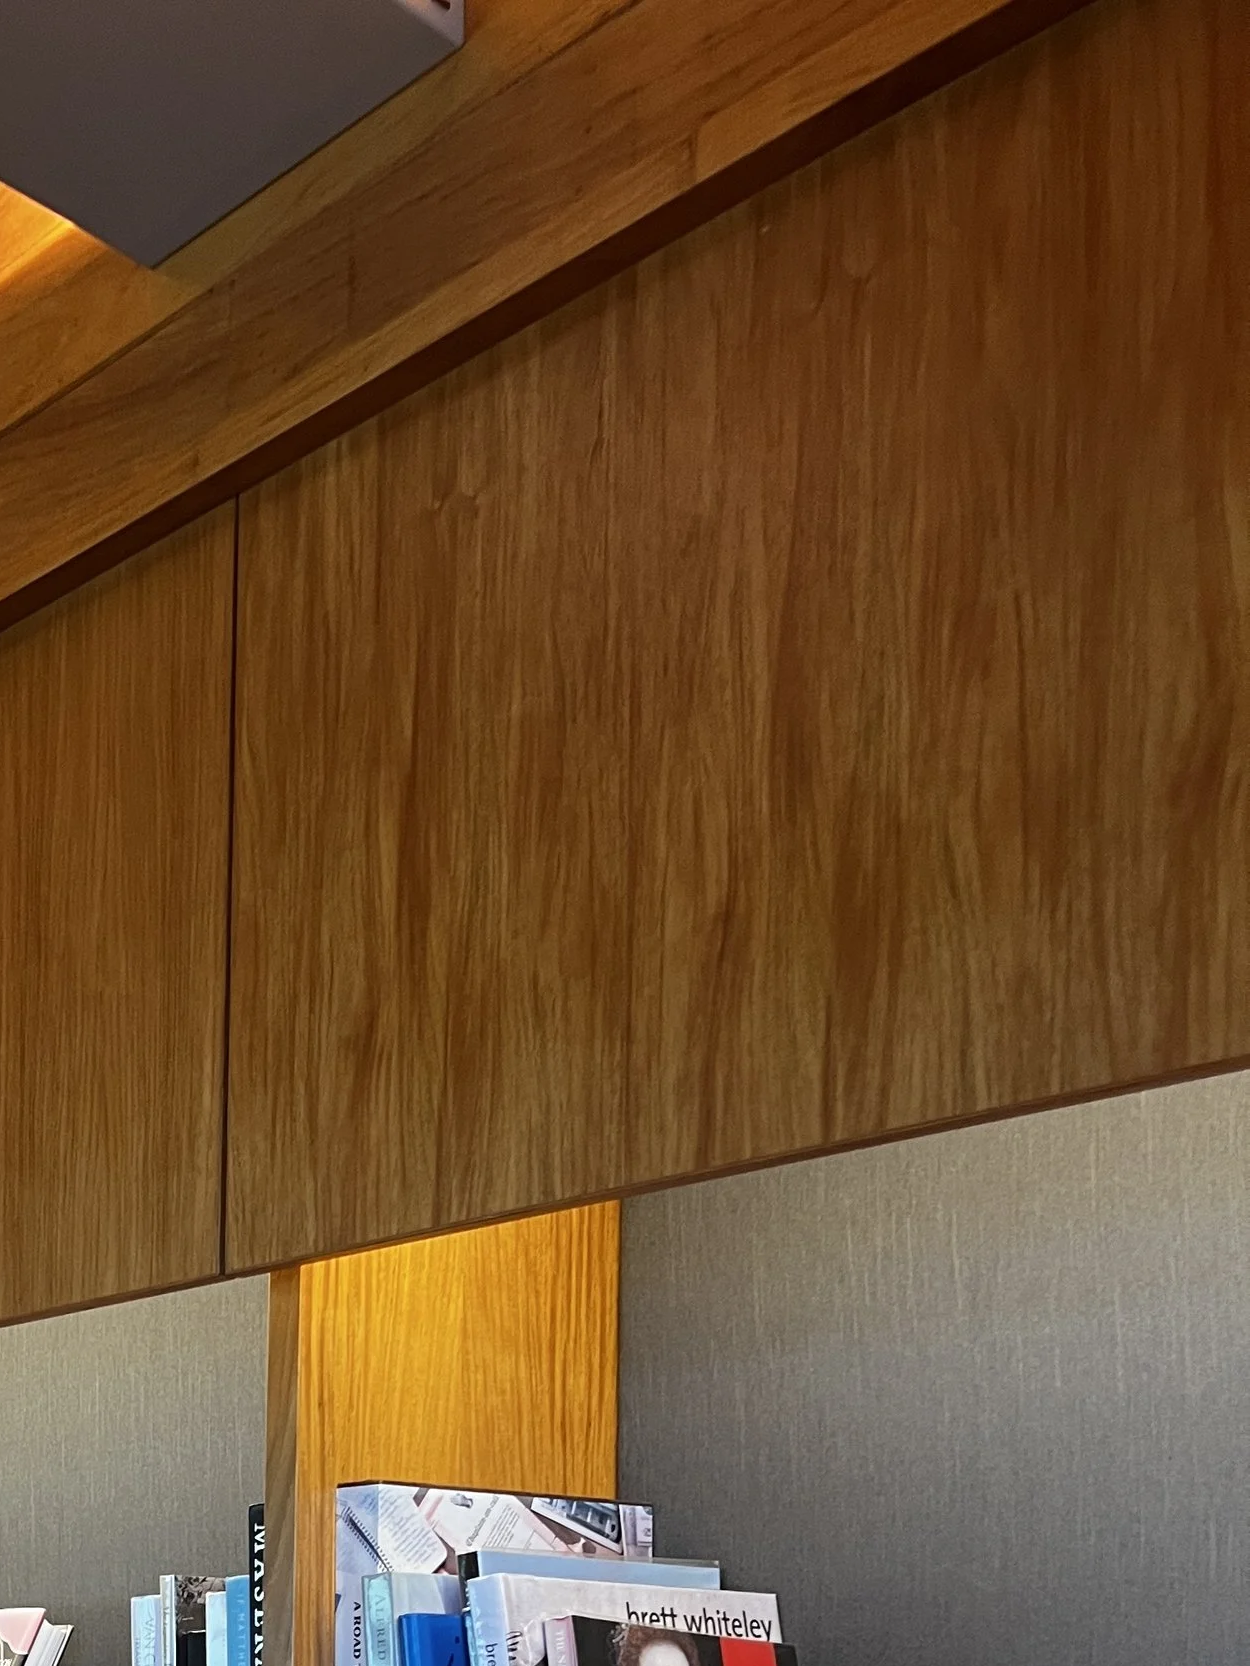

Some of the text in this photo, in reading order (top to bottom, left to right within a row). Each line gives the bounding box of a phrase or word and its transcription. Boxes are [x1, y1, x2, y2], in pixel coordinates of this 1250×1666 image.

[351, 1600, 362, 1612] A
[626, 1601, 772, 1641] brett whiteley
[351, 1615, 362, 1659] ROAD
[374, 1594, 388, 1660] ALFRED
[554, 1630, 565, 1652] THE
